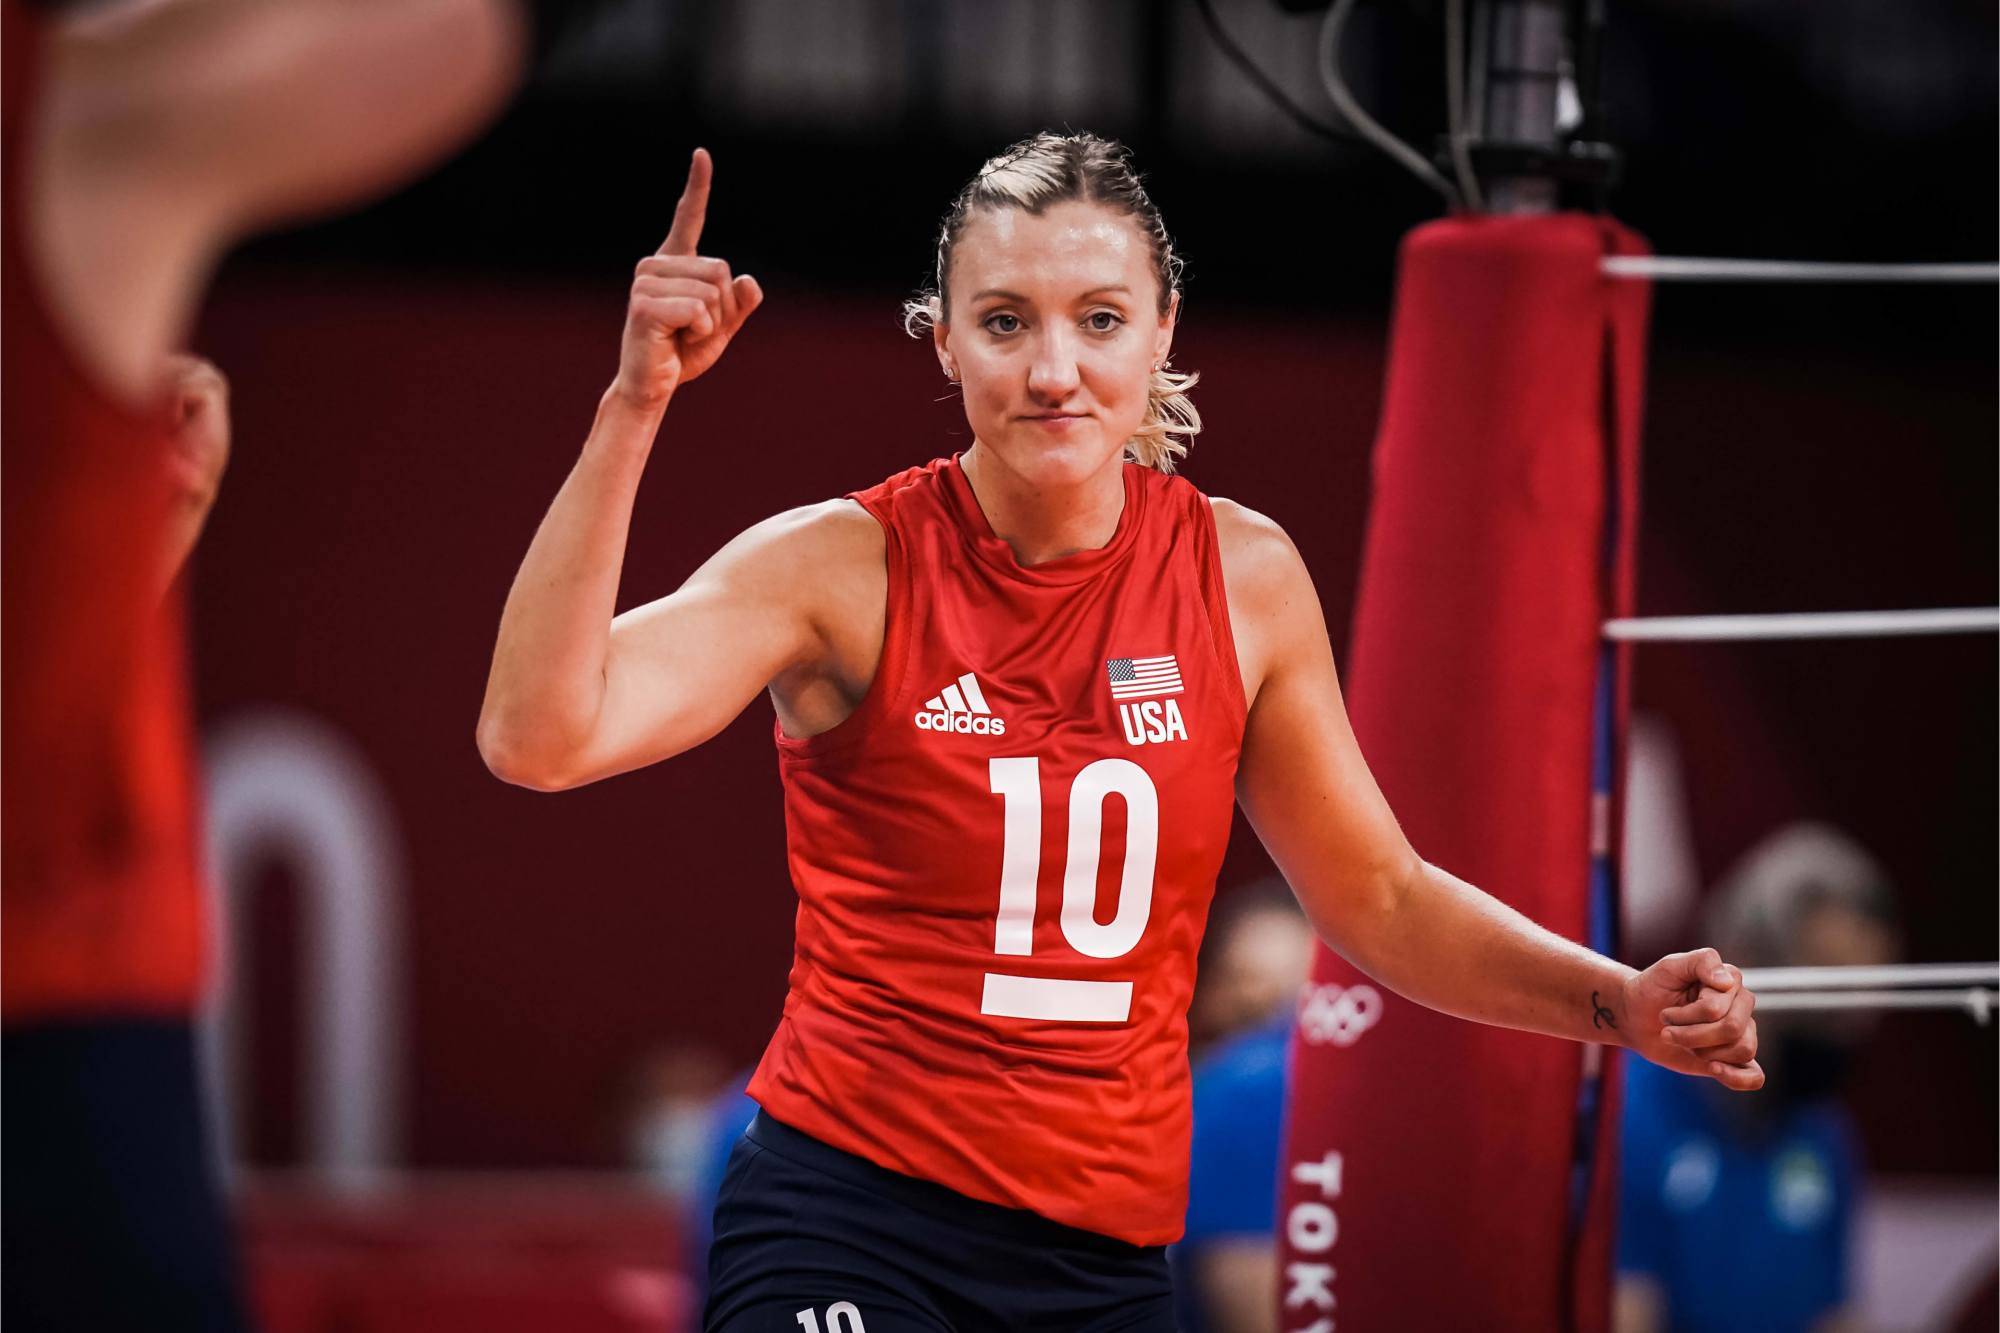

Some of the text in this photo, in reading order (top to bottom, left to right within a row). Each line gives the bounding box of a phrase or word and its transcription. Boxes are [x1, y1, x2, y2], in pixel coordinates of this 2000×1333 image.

[914, 709, 1006, 736] adidas
[1119, 698, 1189, 746] USA
[988, 756, 1159, 959] 10
[1285, 1150, 1343, 1333] TOK
